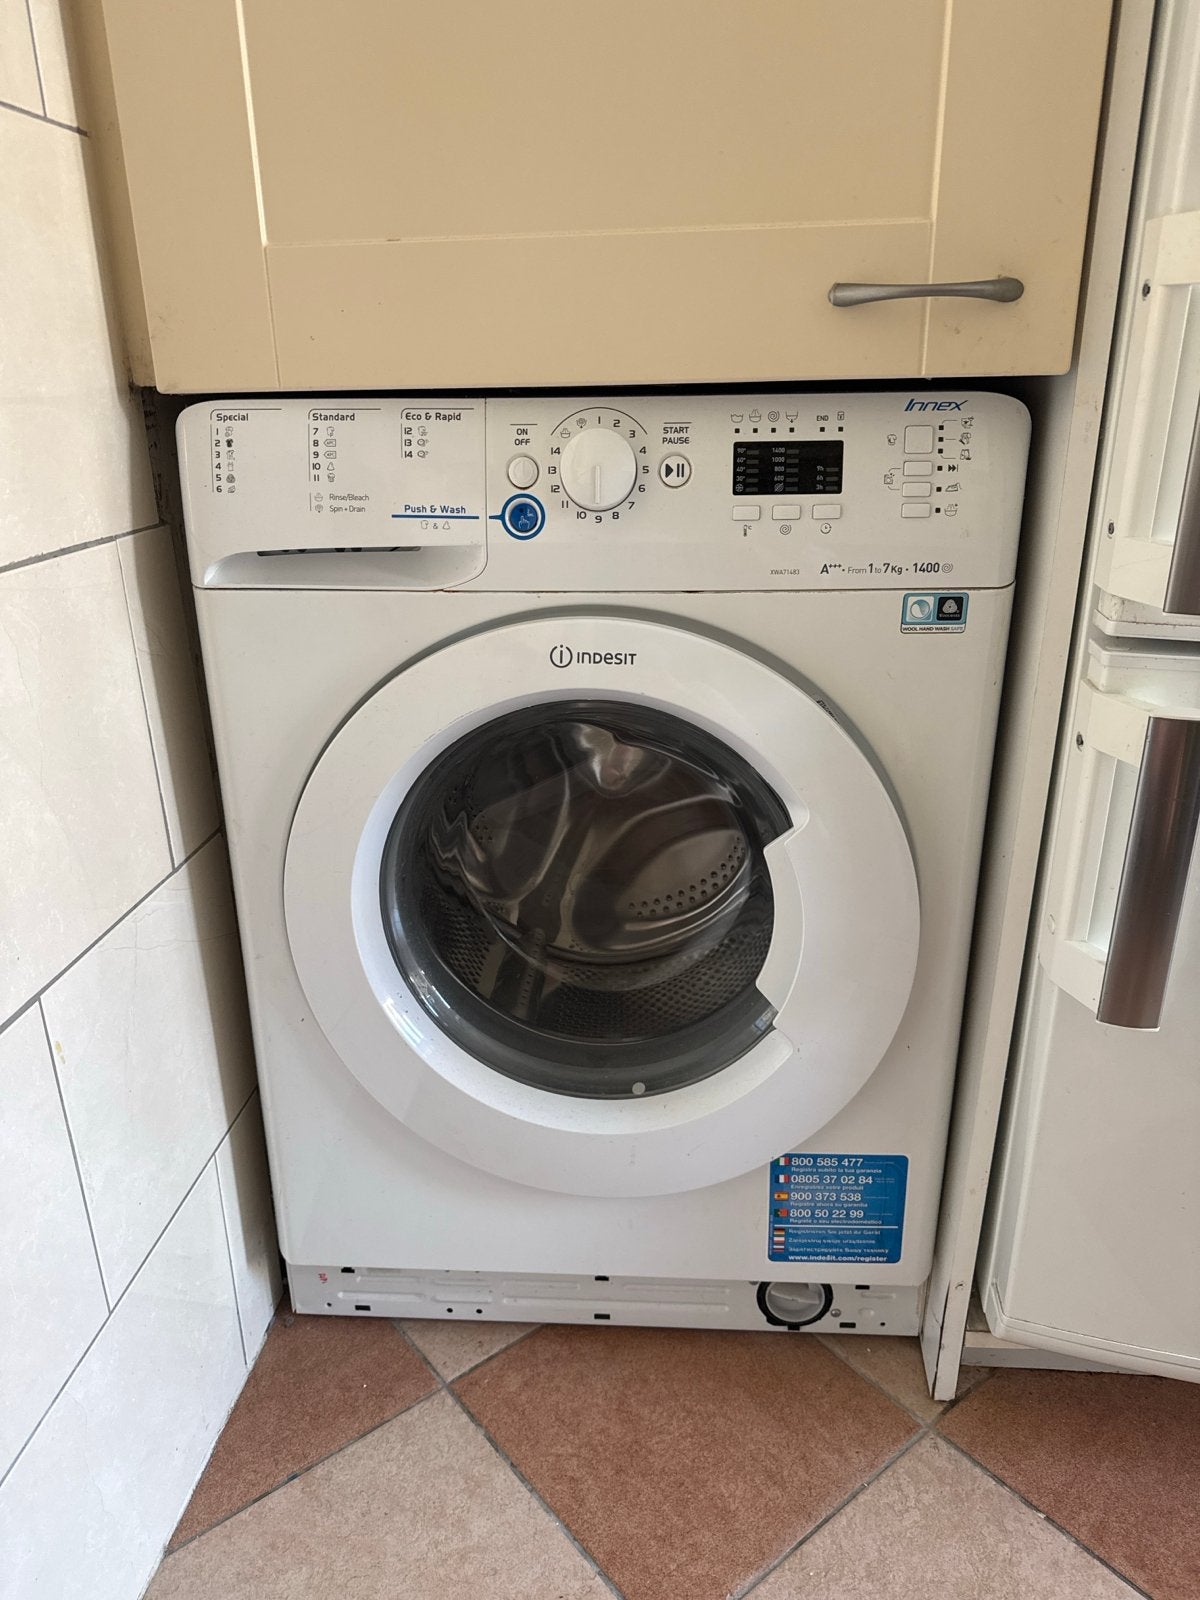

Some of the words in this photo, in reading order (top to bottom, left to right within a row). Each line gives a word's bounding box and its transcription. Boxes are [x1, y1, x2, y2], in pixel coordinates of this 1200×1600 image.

[904, 398, 968, 411] Innex
[216, 413, 249, 423] Special
[312, 413, 355, 421] Standard
[405, 413, 422, 421] Eco
[425, 413, 432, 421] &
[435, 412, 461, 423] Rapid
[613, 419, 620, 427] 2
[404, 427, 412, 435] 12
[516, 428, 528, 436] ON
[629, 430, 636, 438] 3
[663, 426, 689, 434] START
[514, 438, 530, 446] OFF
[404, 450, 413, 458] 14
[639, 446, 646, 454] 4
[548, 466, 557, 474] 13
[642, 466, 649, 474] 5
[329, 493, 369, 501] Rinse/Bleach
[329, 505, 343, 514] Spin
[404, 504, 427, 513] Push
[430, 505, 436, 513] &
[439, 505, 466, 514] Wash
[577, 511, 587, 519] 10
[595, 515, 602, 523] 9
[848, 566, 867, 574] From
[868, 563, 873, 574] 1
[913, 562, 940, 573] 1400
[792, 1157, 813, 1166] 800
[817, 1158, 838, 1166] 585
[842, 1158, 863, 1167] 477
[791, 1175, 820, 1183] 0805
[823, 1175, 837, 1183] 37
[840, 1176, 855, 1184] 02
[858, 1176, 873, 1184] 84
[791, 1192, 812, 1200] 900
[815, 1193, 837, 1201] 373
[840, 1193, 861, 1201] 538
[790, 1208, 811, 1217] 800
[814, 1209, 829, 1218] 50
[832, 1209, 846, 1218] 22
[849, 1209, 864, 1218] 99
